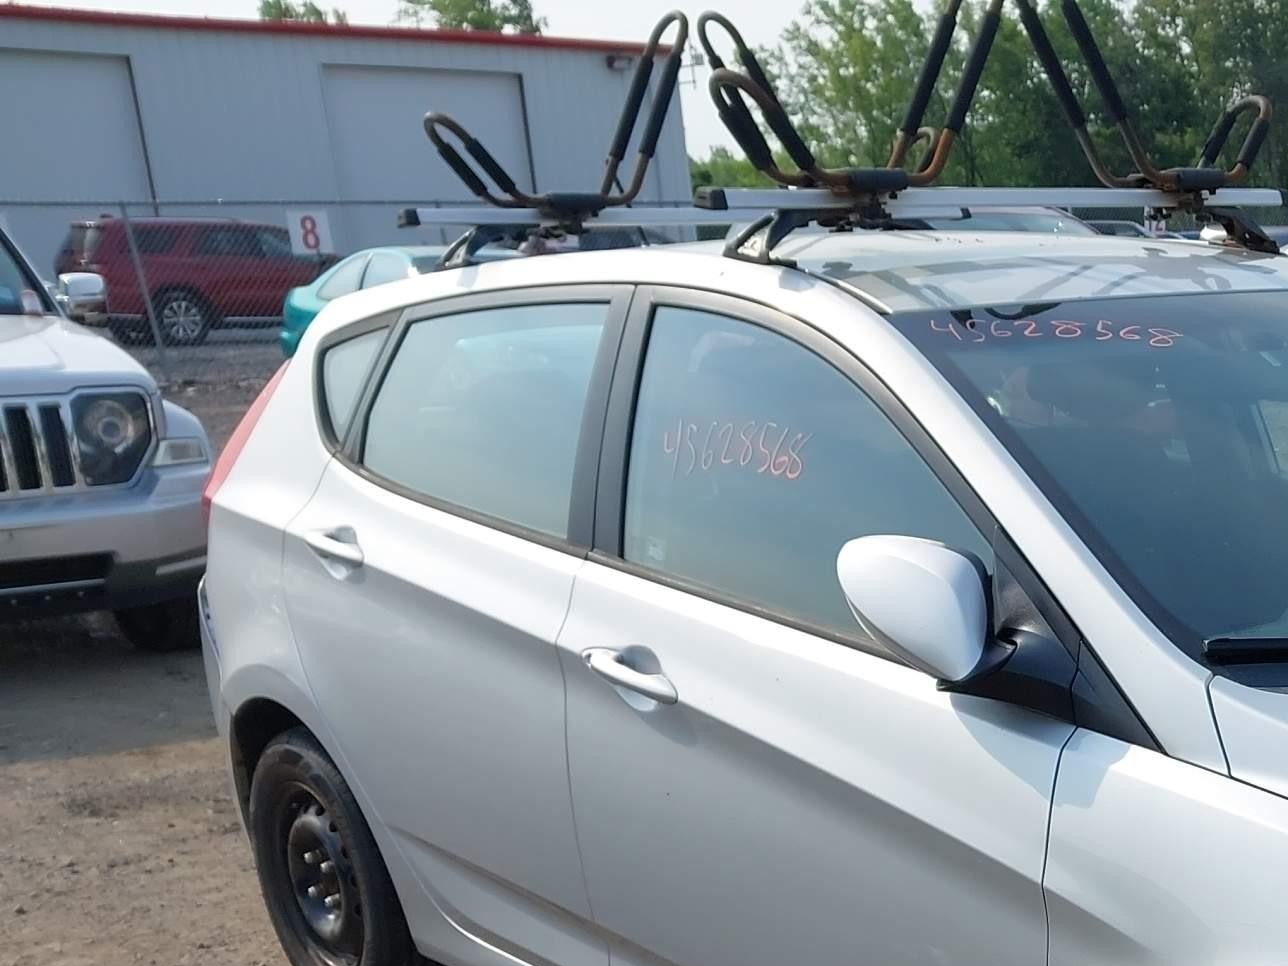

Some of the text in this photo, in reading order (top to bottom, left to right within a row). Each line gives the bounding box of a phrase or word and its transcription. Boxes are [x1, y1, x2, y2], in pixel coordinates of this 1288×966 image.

[300, 214, 320, 249] 8
[929, 318, 1184, 348] 45628568
[663, 417, 815, 479] 45628568
